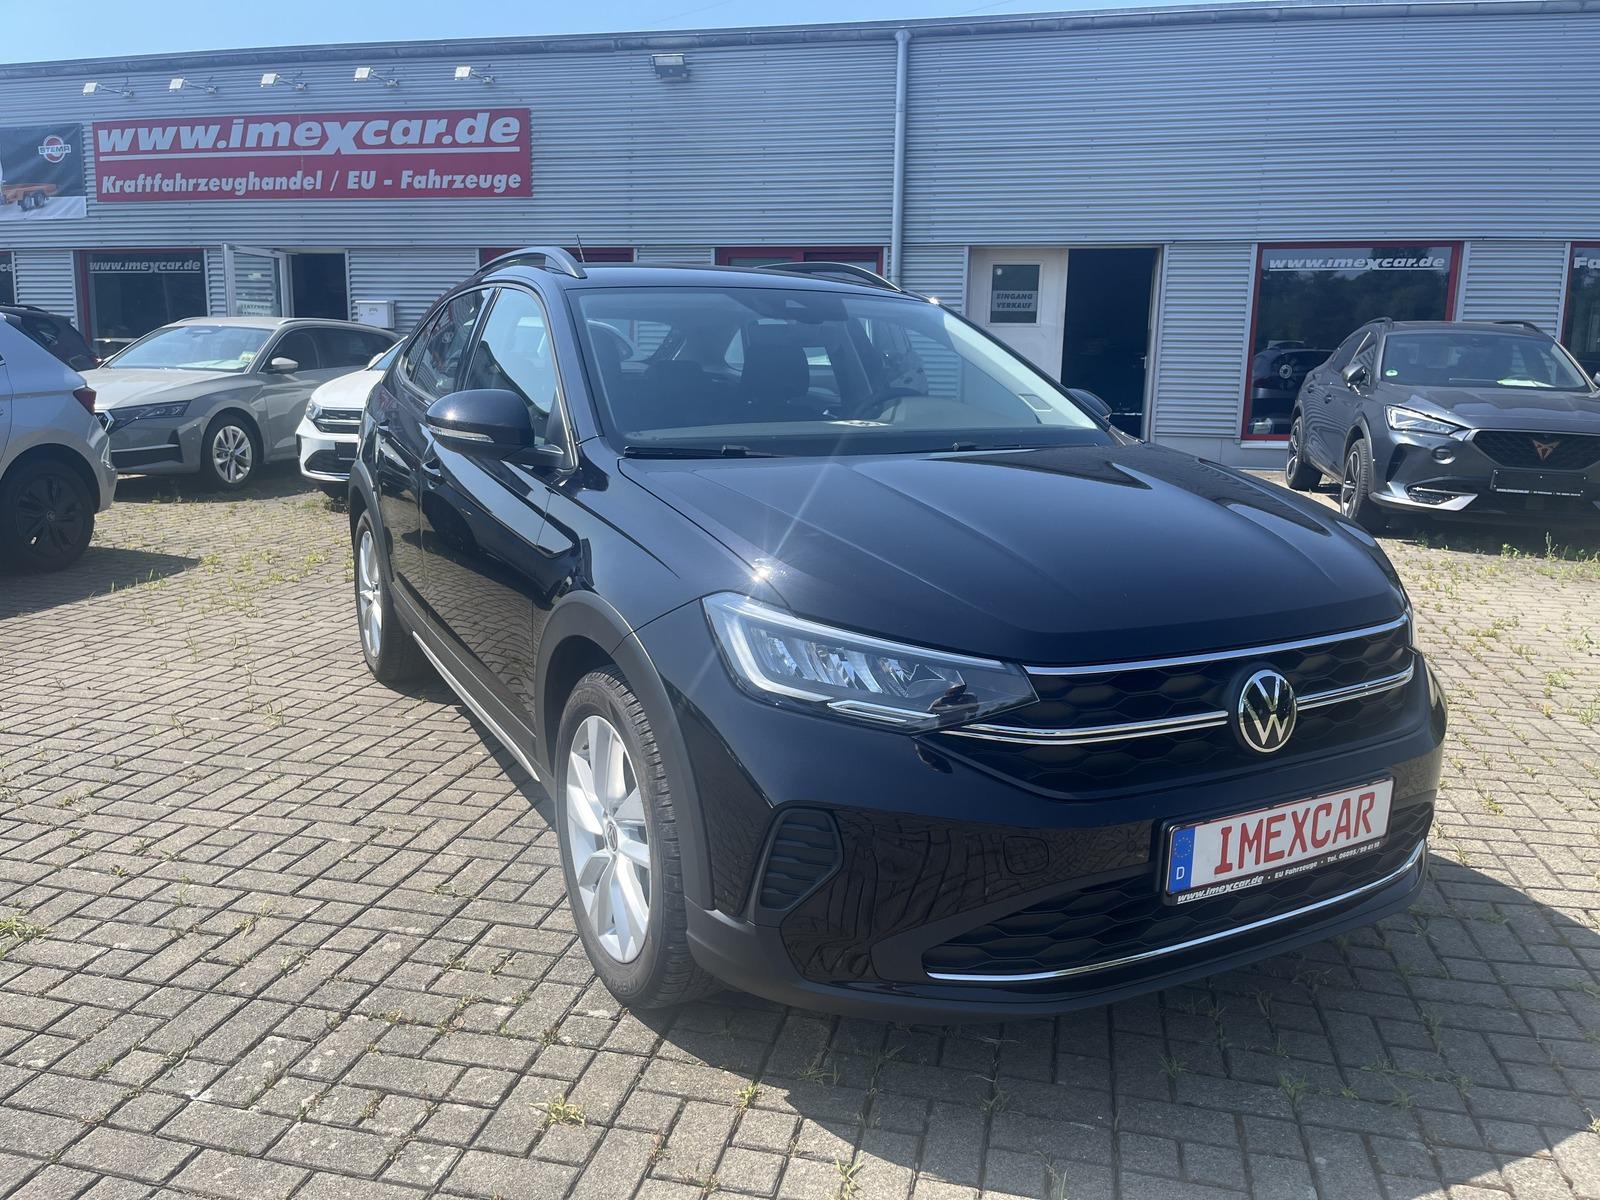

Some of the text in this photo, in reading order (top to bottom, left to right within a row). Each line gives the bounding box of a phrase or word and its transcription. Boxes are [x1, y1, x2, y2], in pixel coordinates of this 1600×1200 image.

[98, 112, 520, 155] www.imexcar.de
[39, 145, 70, 154] STEMA
[102, 170, 323, 196] Kraftfahrzeughandel
[347, 170, 377, 190] EU
[400, 169, 521, 193] Fahrzeuge
[89, 260, 201, 273] www.imexcar.de
[1269, 256, 1445, 270] www.imexcar.de
[1214, 791, 1376, 875] IMEXCAR
[1175, 866, 1185, 880] D
[1177, 874, 1264, 903] www.imexcar.de
[1274, 870, 1284, 879] EU
[1285, 861, 1318, 876] Fahrzeuge
